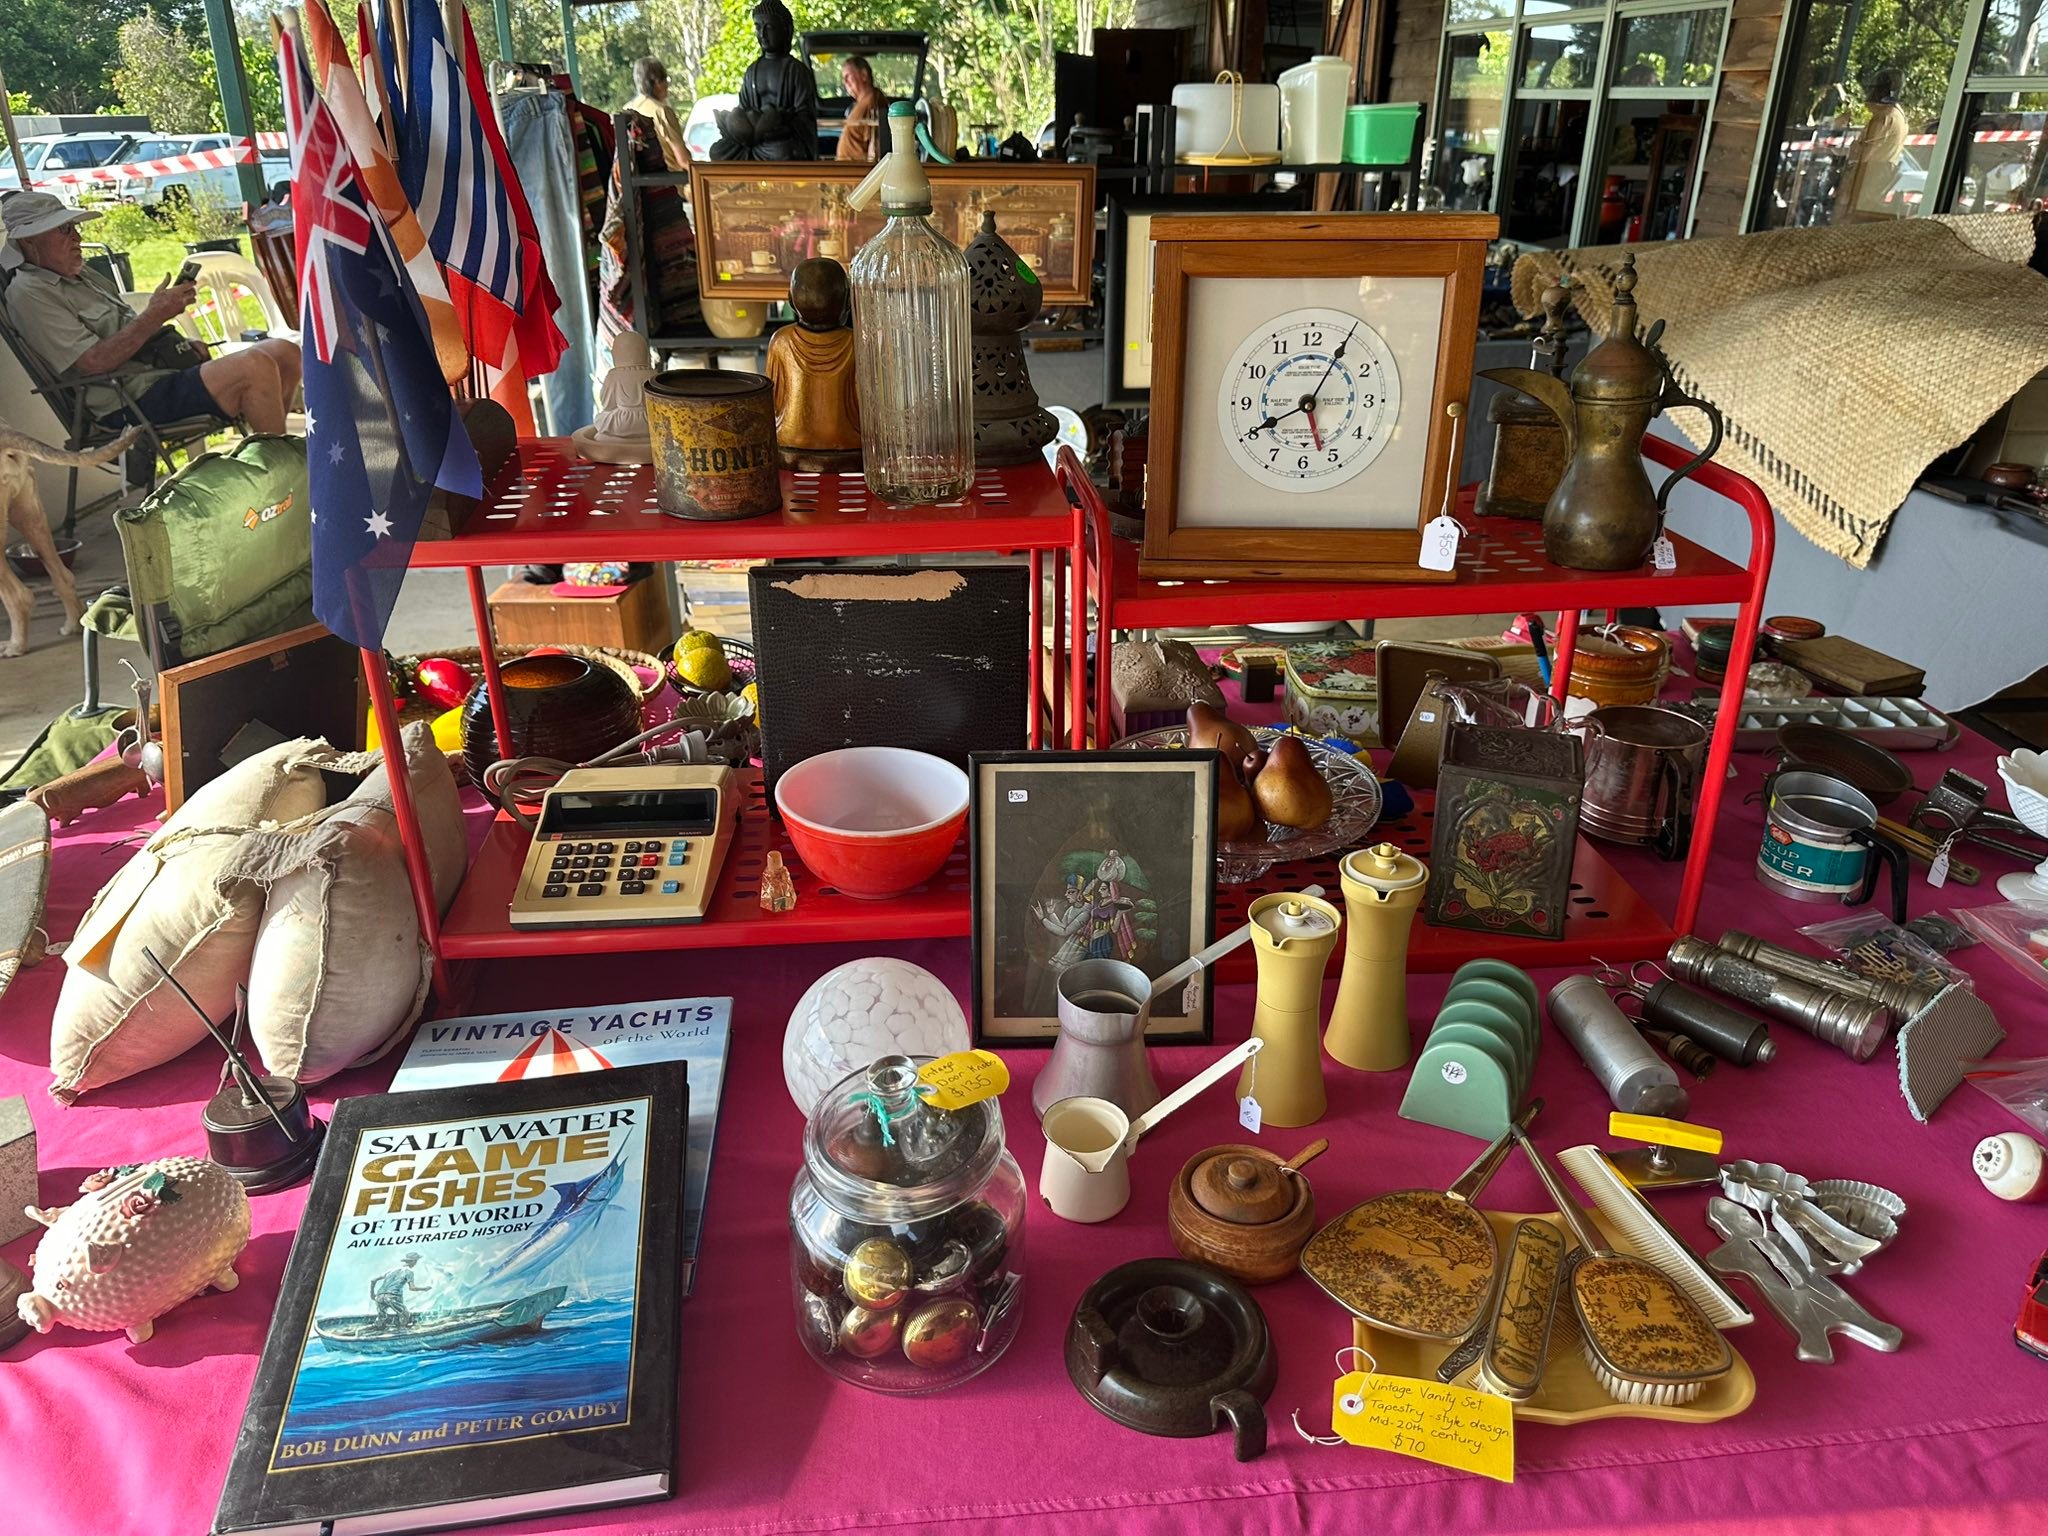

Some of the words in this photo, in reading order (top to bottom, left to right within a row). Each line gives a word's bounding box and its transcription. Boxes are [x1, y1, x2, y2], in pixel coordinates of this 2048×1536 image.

[1272, 340, 1288, 354] 11
[1303, 332, 1323, 346] 12
[1248, 365, 1266, 379] 10
[1359, 363, 1370, 378] 2
[1240, 396, 1252, 410] 9
[1363, 394, 1375, 408] 3
[1248, 426, 1260, 440] 8
[1352, 426, 1363, 439] 4
[1269, 448, 1280, 462] 7
[1298, 456, 1309, 469] 6
[1327, 449, 1339, 462] 5
[1439, 533, 1454, 557] $50
[1009, 790, 1024, 801] $30
[1767, 840, 1800, 859] CUP
[1760, 844, 1814, 877] IFTER
[430, 1018, 575, 1043] VINTAGE
[589, 1005, 715, 1032] YACHTS
[603, 1034, 625, 1046] of
[628, 1031, 654, 1043] the
[661, 1026, 711, 1041] World
[935, 1070, 965, 1088] Door
[949, 1073, 992, 1098] $135
[368, 1107, 638, 1155] SALTWATER
[361, 1131, 610, 1184] GAME
[352, 1168, 547, 1217] FISHES
[350, 1221, 387, 1236] OF
[391, 1214, 441, 1232] THE
[449, 1202, 544, 1226] WORLD
[346, 1238, 372, 1249] AN
[374, 1229, 468, 1247] ILLUSTRATED
[471, 1221, 535, 1238] HISTORY
[1369, 1380, 1414, 1399] Vintage
[1420, 1386, 1457, 1413] Vanity
[1371, 1400, 1425, 1423] Tapestry
[280, 1441, 327, 1459] BOB
[332, 1430, 404, 1454] DUNN
[408, 1422, 447, 1442] and
[454, 1414, 524, 1436] PETER
[530, 1401, 623, 1426] GOADBY
[1391, 1431, 1426, 1453] $70
